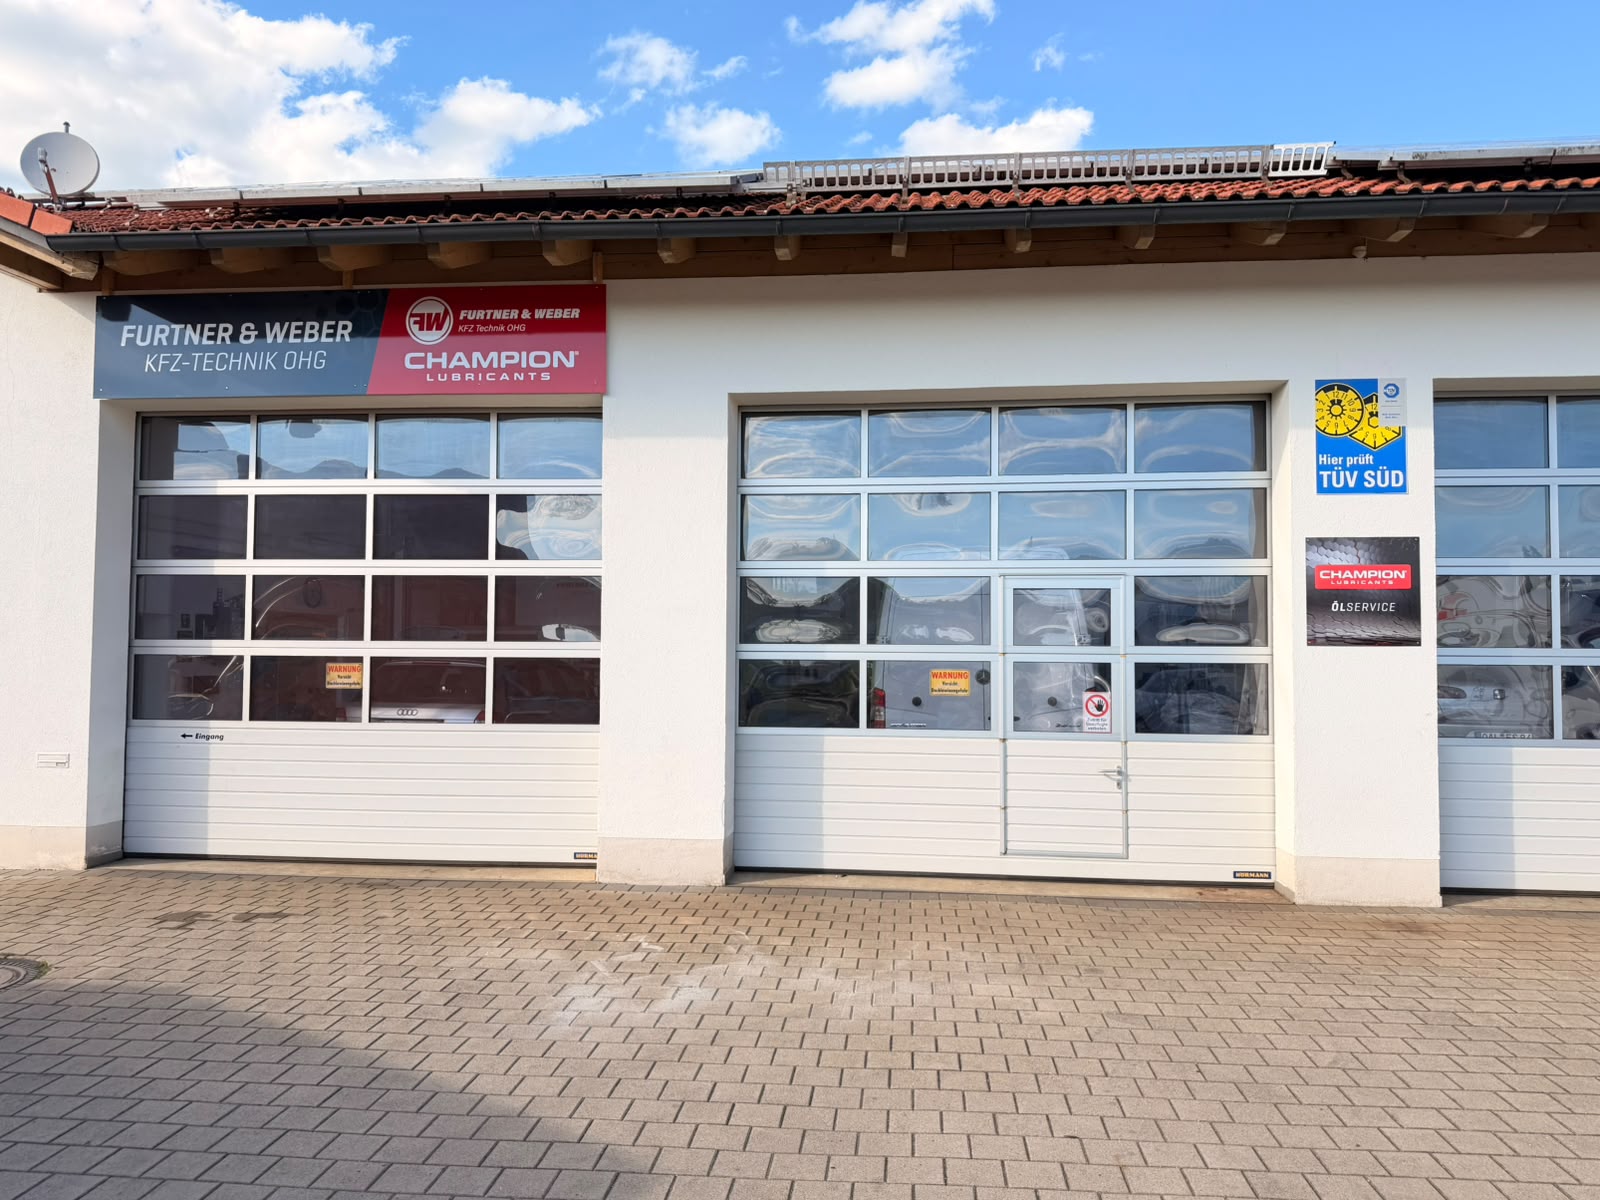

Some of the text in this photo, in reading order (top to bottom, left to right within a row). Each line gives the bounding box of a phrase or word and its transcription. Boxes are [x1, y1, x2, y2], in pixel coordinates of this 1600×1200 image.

[459, 308, 581, 320] FURTNER & WEBER
[120, 320, 353, 347] FURTNER & WEBER
[476, 324, 505, 332] Technik
[506, 324, 526, 332] OHG
[144, 350, 327, 373] KFZ-TECHNIK OHG
[404, 351, 576, 369] CHAMPION
[426, 372, 551, 381] LUBRICANTS
[1318, 453, 1374, 467] Hier prüft
[1319, 466, 1404, 488] TÜV SÜD
[1319, 570, 1406, 579] CHAMPION
[1331, 600, 1396, 612] ÖLSERVICE
[328, 665, 361, 673] WARNUNG
[931, 671, 969, 679] WARNUNG
[195, 733, 224, 741] Eingang
